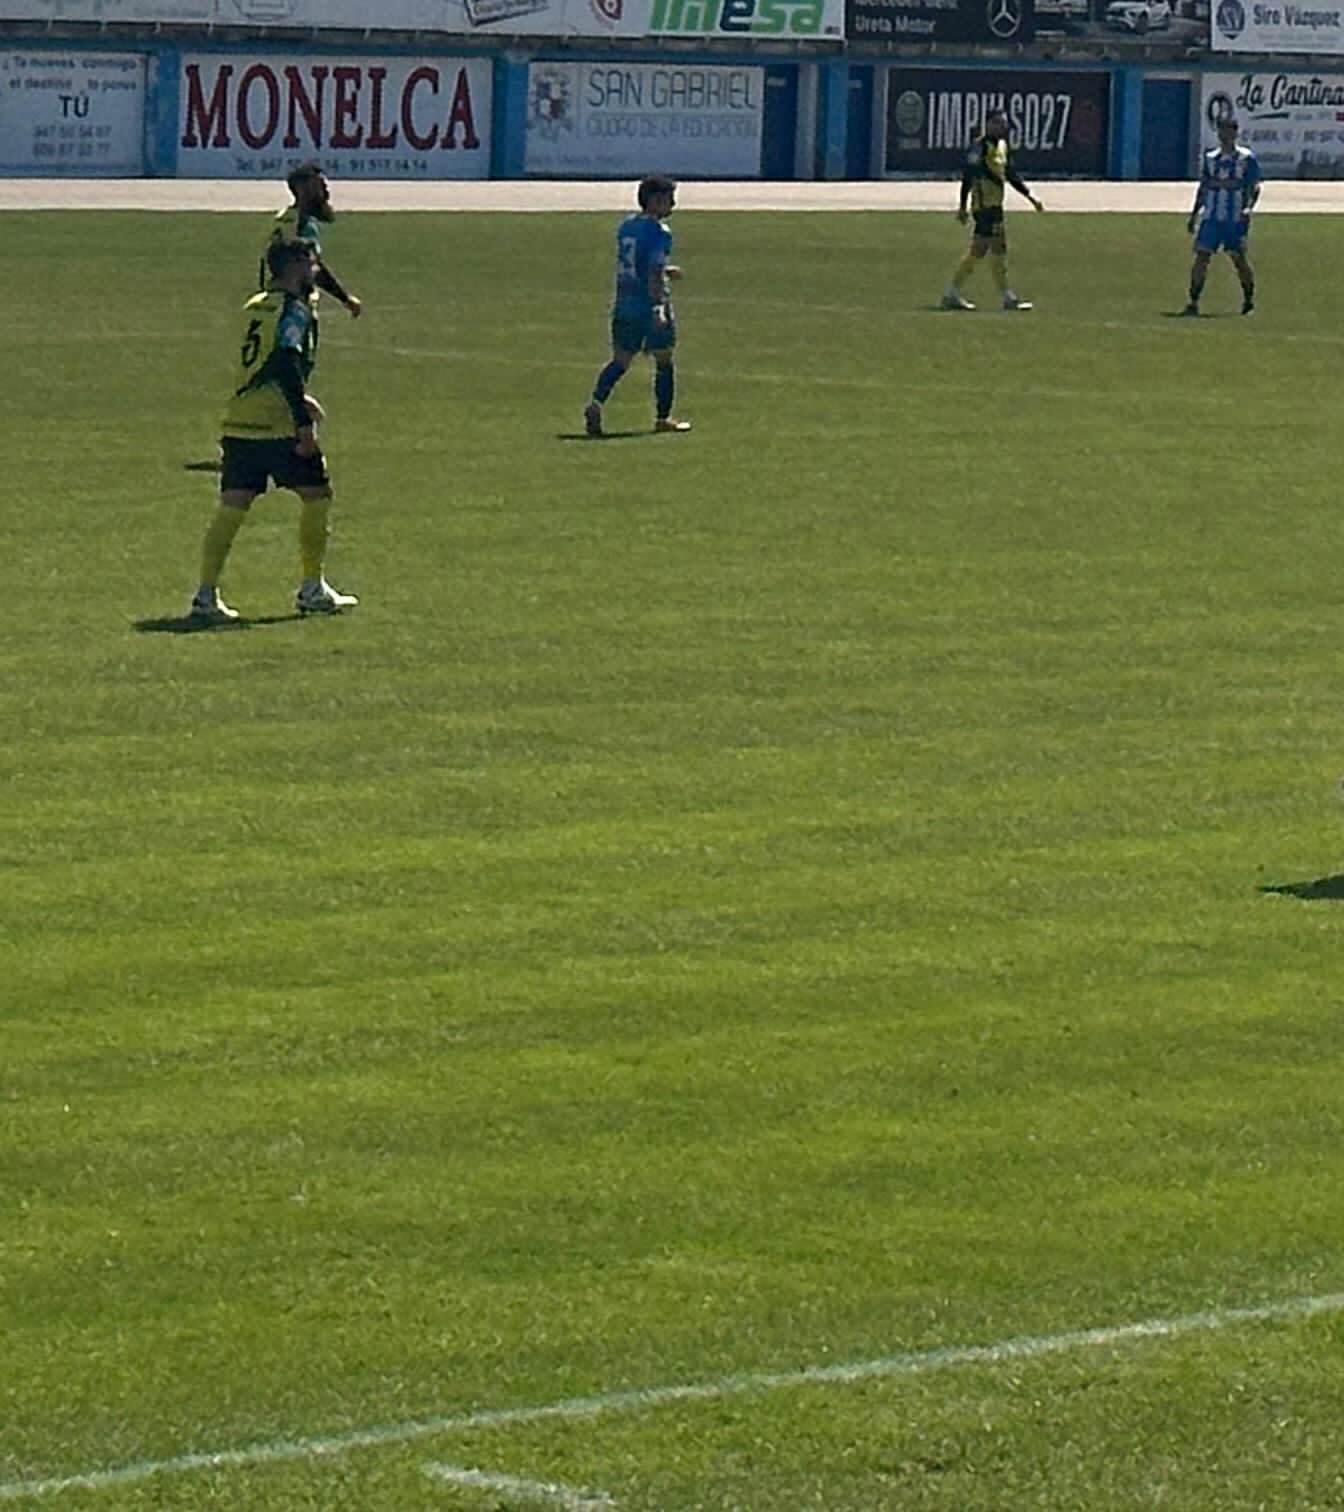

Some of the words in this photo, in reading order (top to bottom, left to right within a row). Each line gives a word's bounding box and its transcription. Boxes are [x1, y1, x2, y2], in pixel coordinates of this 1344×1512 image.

[181, 63, 480, 151] MONELCA
[588, 70, 642, 107] SAN
[651, 71, 756, 109] GABRIEL
[1236, 74, 1264, 112] La
